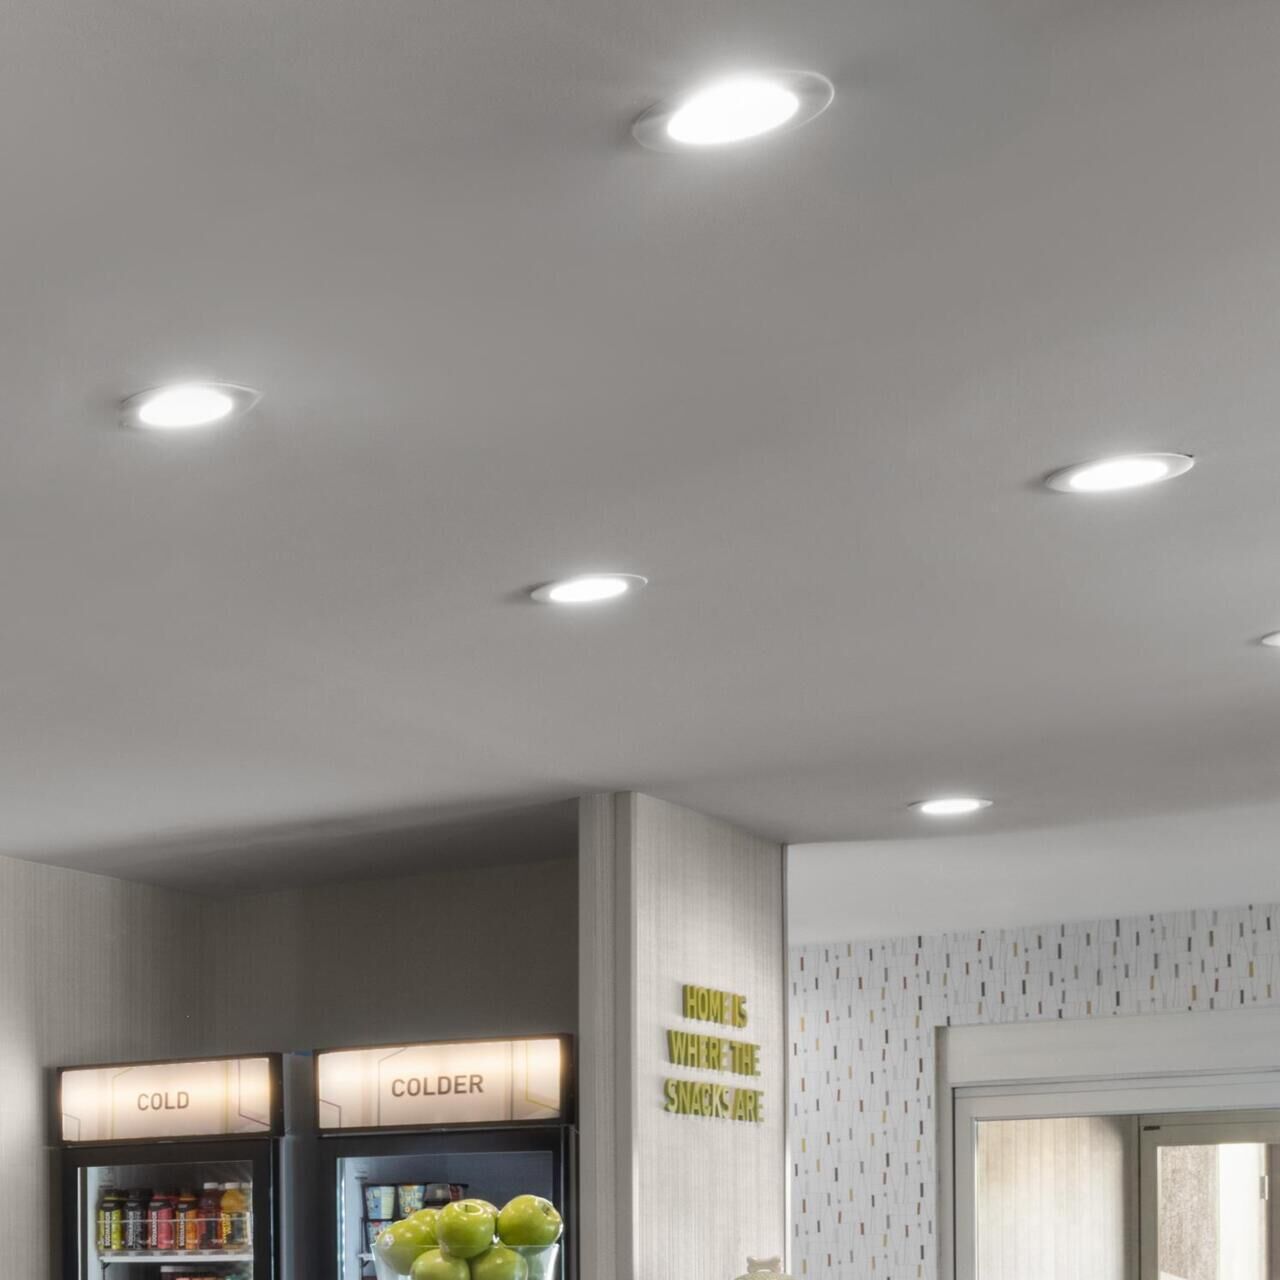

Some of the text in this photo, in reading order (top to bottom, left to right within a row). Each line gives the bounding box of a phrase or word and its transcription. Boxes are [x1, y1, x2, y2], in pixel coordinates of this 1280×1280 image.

[682, 984, 731, 1026] HOME
[666, 1029, 761, 1077] WHERE THE
[137, 1091, 189, 1112] COLD
[391, 1074, 484, 1098] COLDER
[663, 1079, 764, 1123] SNACKS ARE
